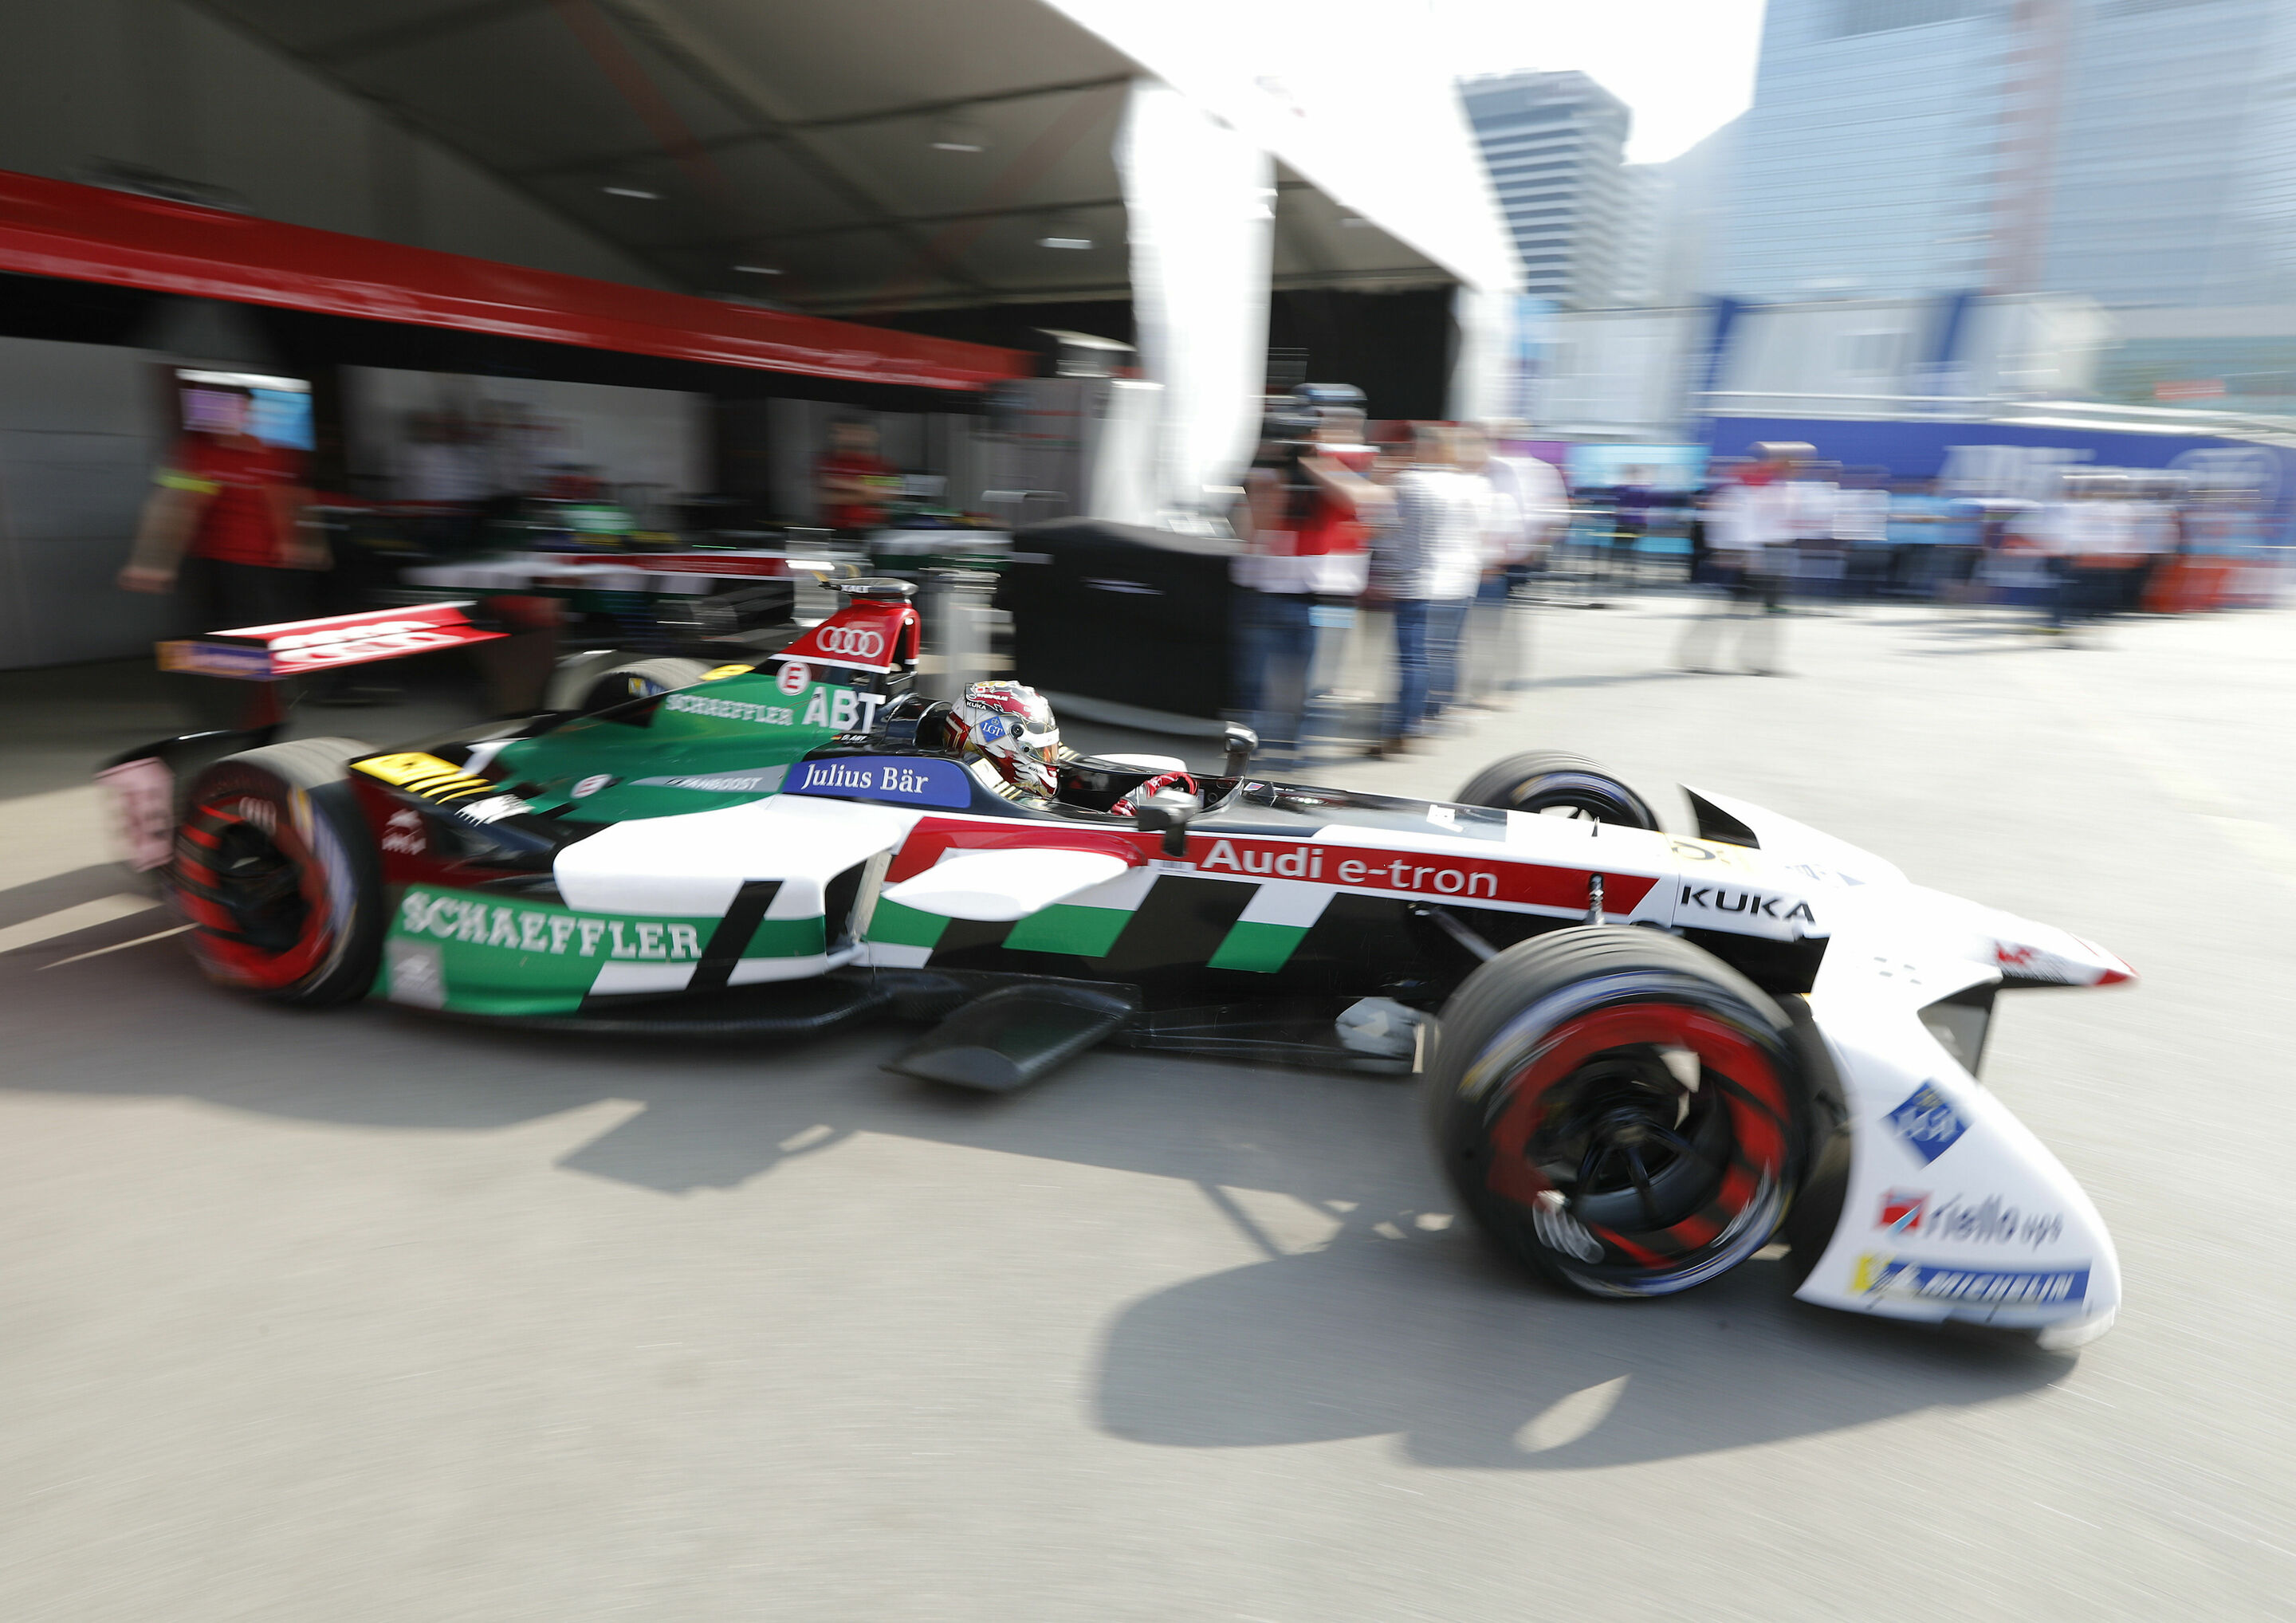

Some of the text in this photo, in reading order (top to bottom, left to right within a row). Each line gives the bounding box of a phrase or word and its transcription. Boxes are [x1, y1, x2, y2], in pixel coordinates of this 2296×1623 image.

[784, 666, 800, 690] E
[666, 693, 794, 726] SCHAEFFLER
[801, 686, 887, 733] ABT
[966, 701, 988, 710] KUKA
[982, 722, 1003, 737] LGT
[800, 763, 930, 794] Julius Bär
[1201, 839, 1499, 898] Audi e-tron
[1680, 885, 1816, 925] KUKA
[401, 890, 702, 959] SCHAEFFLER
